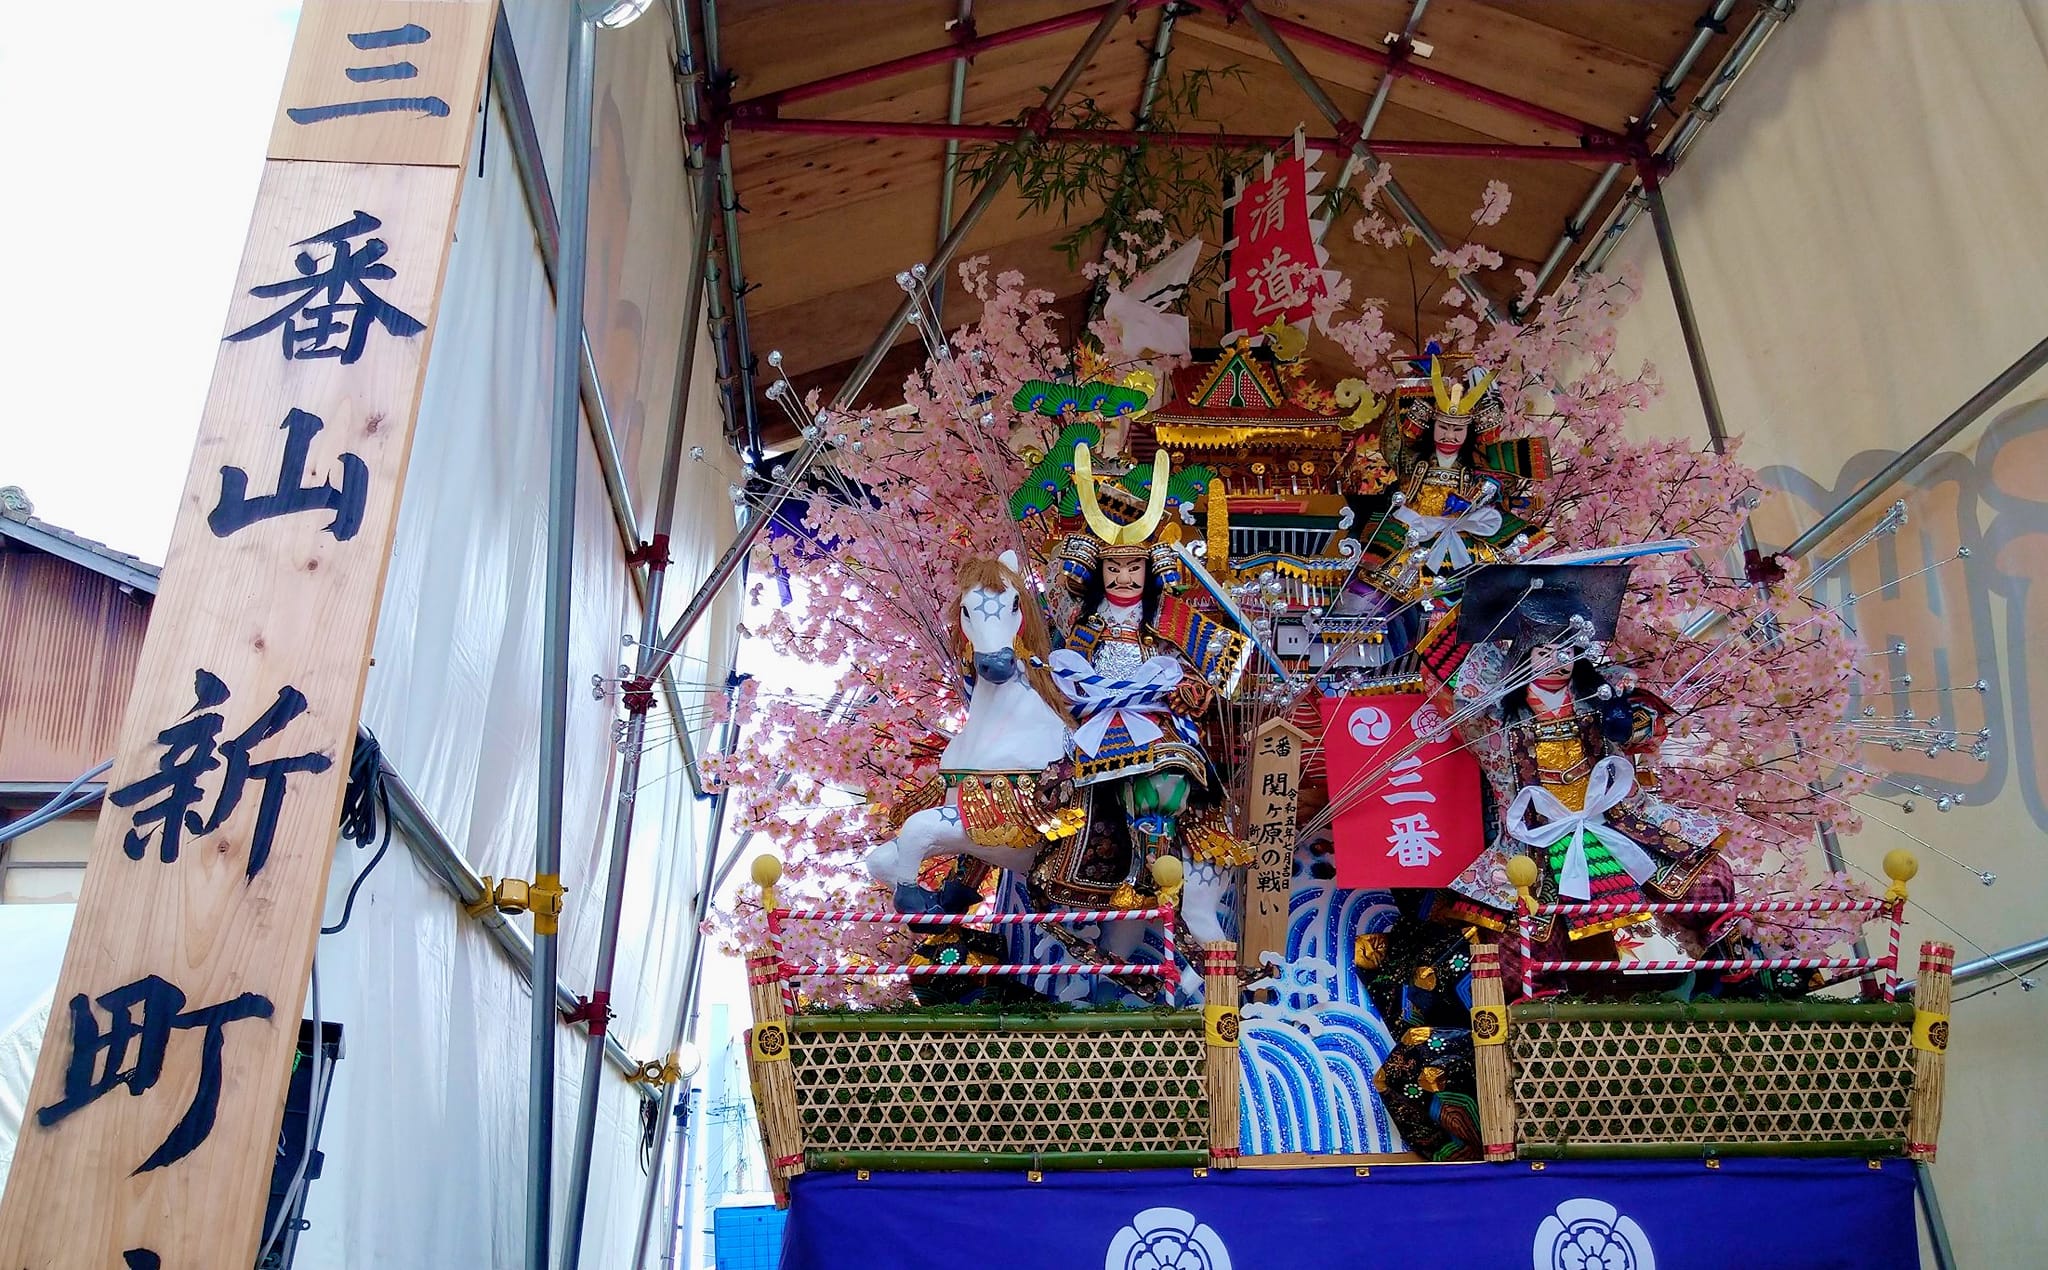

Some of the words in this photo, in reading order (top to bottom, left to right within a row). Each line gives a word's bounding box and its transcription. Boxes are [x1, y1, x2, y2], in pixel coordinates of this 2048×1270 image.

[1246, 176, 1306, 317] 清道
[36, 23, 450, 1270] 三番山新町
[1259, 736, 1292, 757] 三番
[1281, 788, 1298, 891] 令和五年七月吉日
[1381, 756, 1442, 867] 三番
